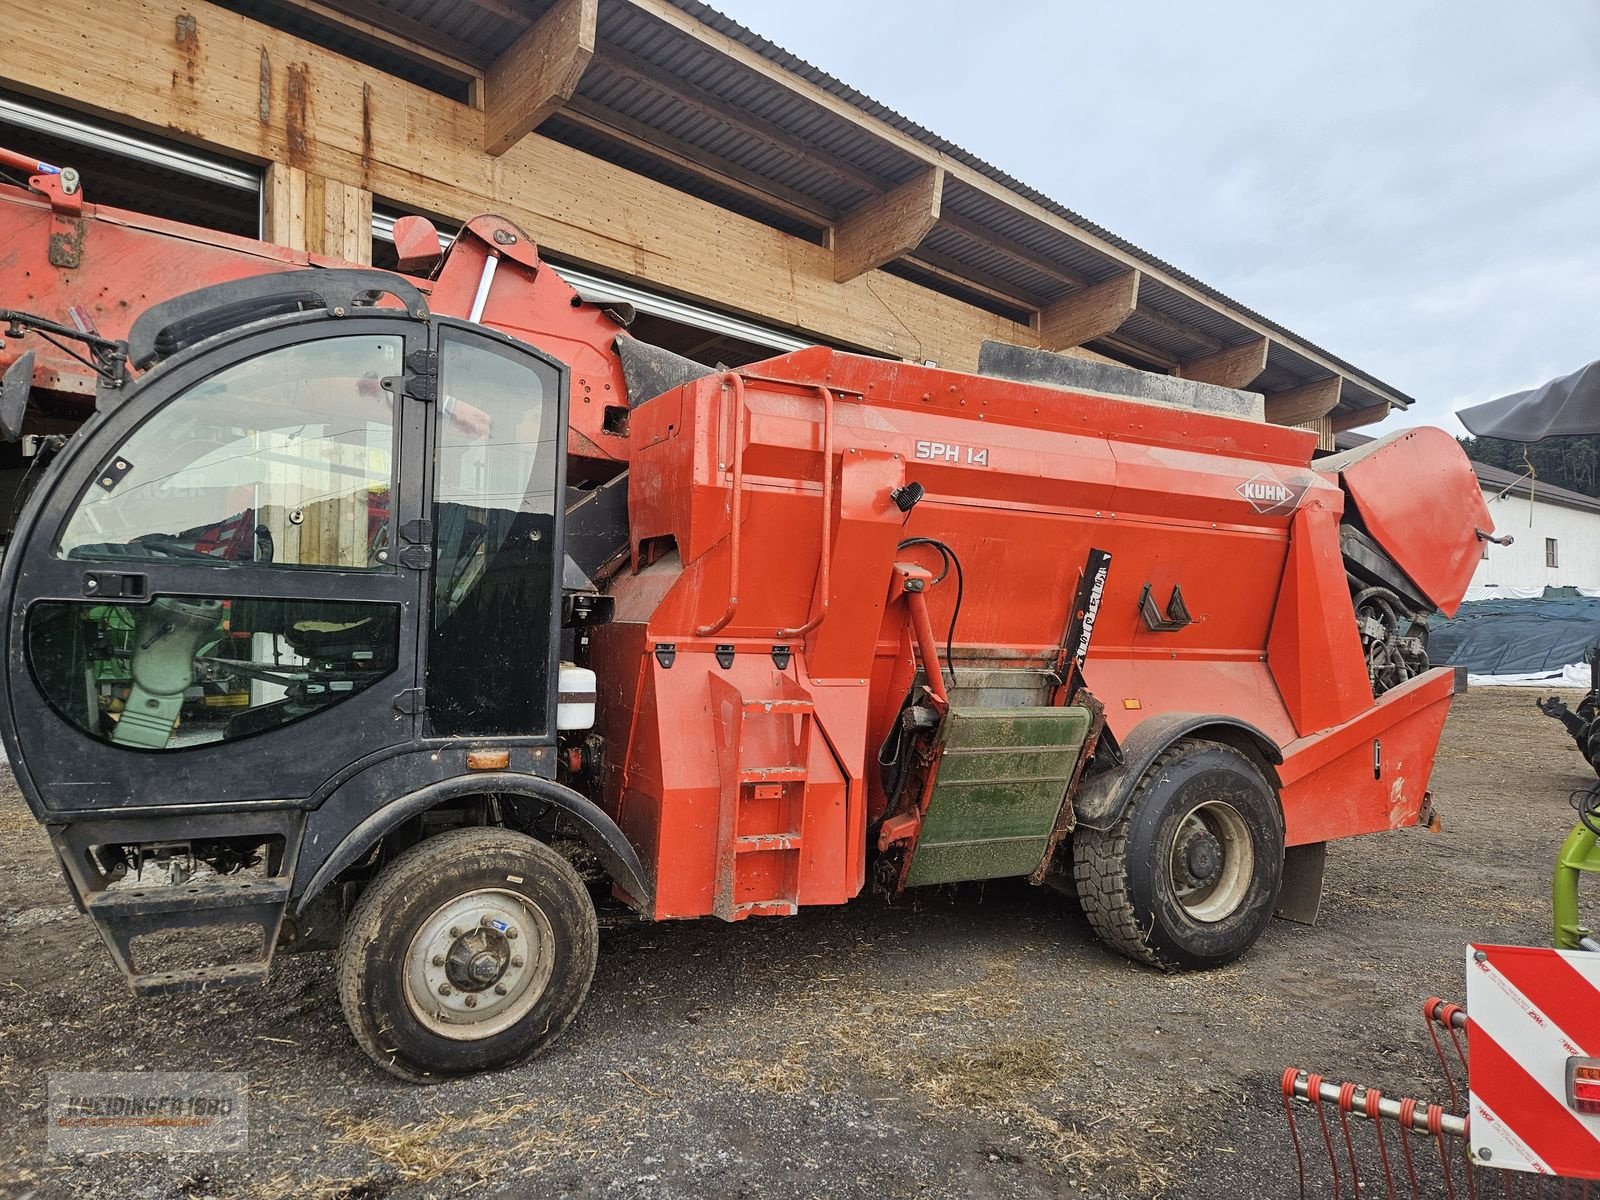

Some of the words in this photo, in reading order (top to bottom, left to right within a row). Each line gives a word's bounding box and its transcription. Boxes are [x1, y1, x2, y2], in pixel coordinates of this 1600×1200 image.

[916, 441, 960, 462] SPH
[967, 447, 988, 466] 14
[1244, 483, 1286, 501] KUHN
